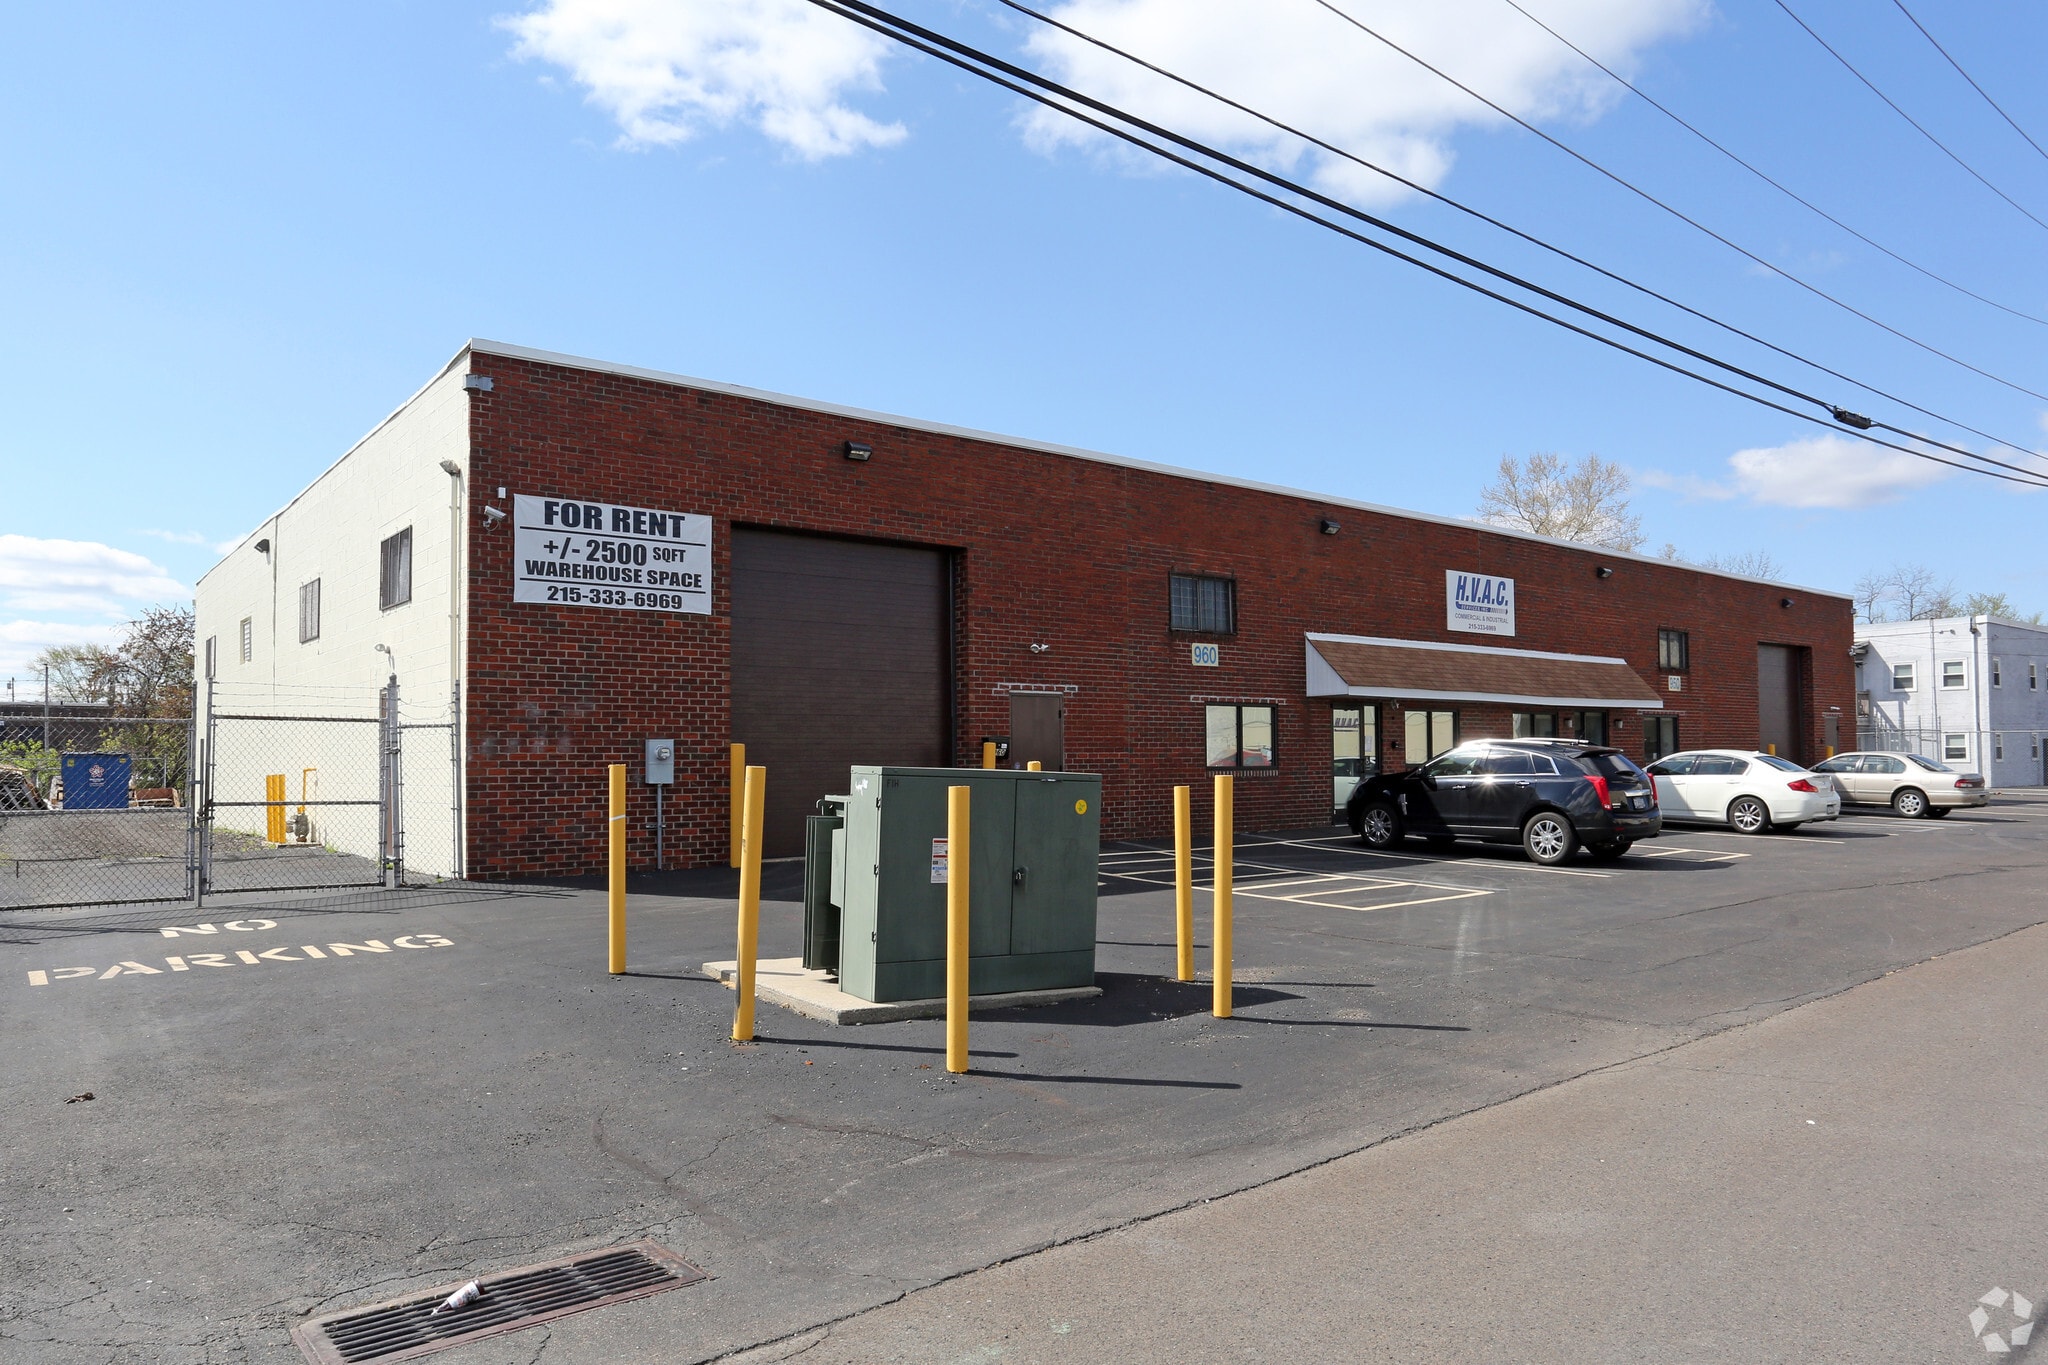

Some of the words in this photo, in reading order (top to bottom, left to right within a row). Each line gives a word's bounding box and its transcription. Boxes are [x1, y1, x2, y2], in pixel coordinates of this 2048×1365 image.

[544, 500, 603, 531] FOR
[611, 508, 686, 539] RENT
[543, 537, 581, 559] +/-
[586, 539, 647, 566] 2500
[652, 547, 686, 563] SQFT
[525, 560, 643, 584] WAREHOUSE
[646, 570, 702, 588] SPACE
[547, 585, 683, 610] 215-333-6969
[1455, 575, 1509, 606] H.V.A.C.
[1455, 612, 1481, 621] COMMERCIAL
[1486, 616, 1508, 624] INDUSTRIAL
[1194, 645, 1217, 664] 960
[159, 919, 278, 938] NO
[27, 934, 455, 986] PARKING
